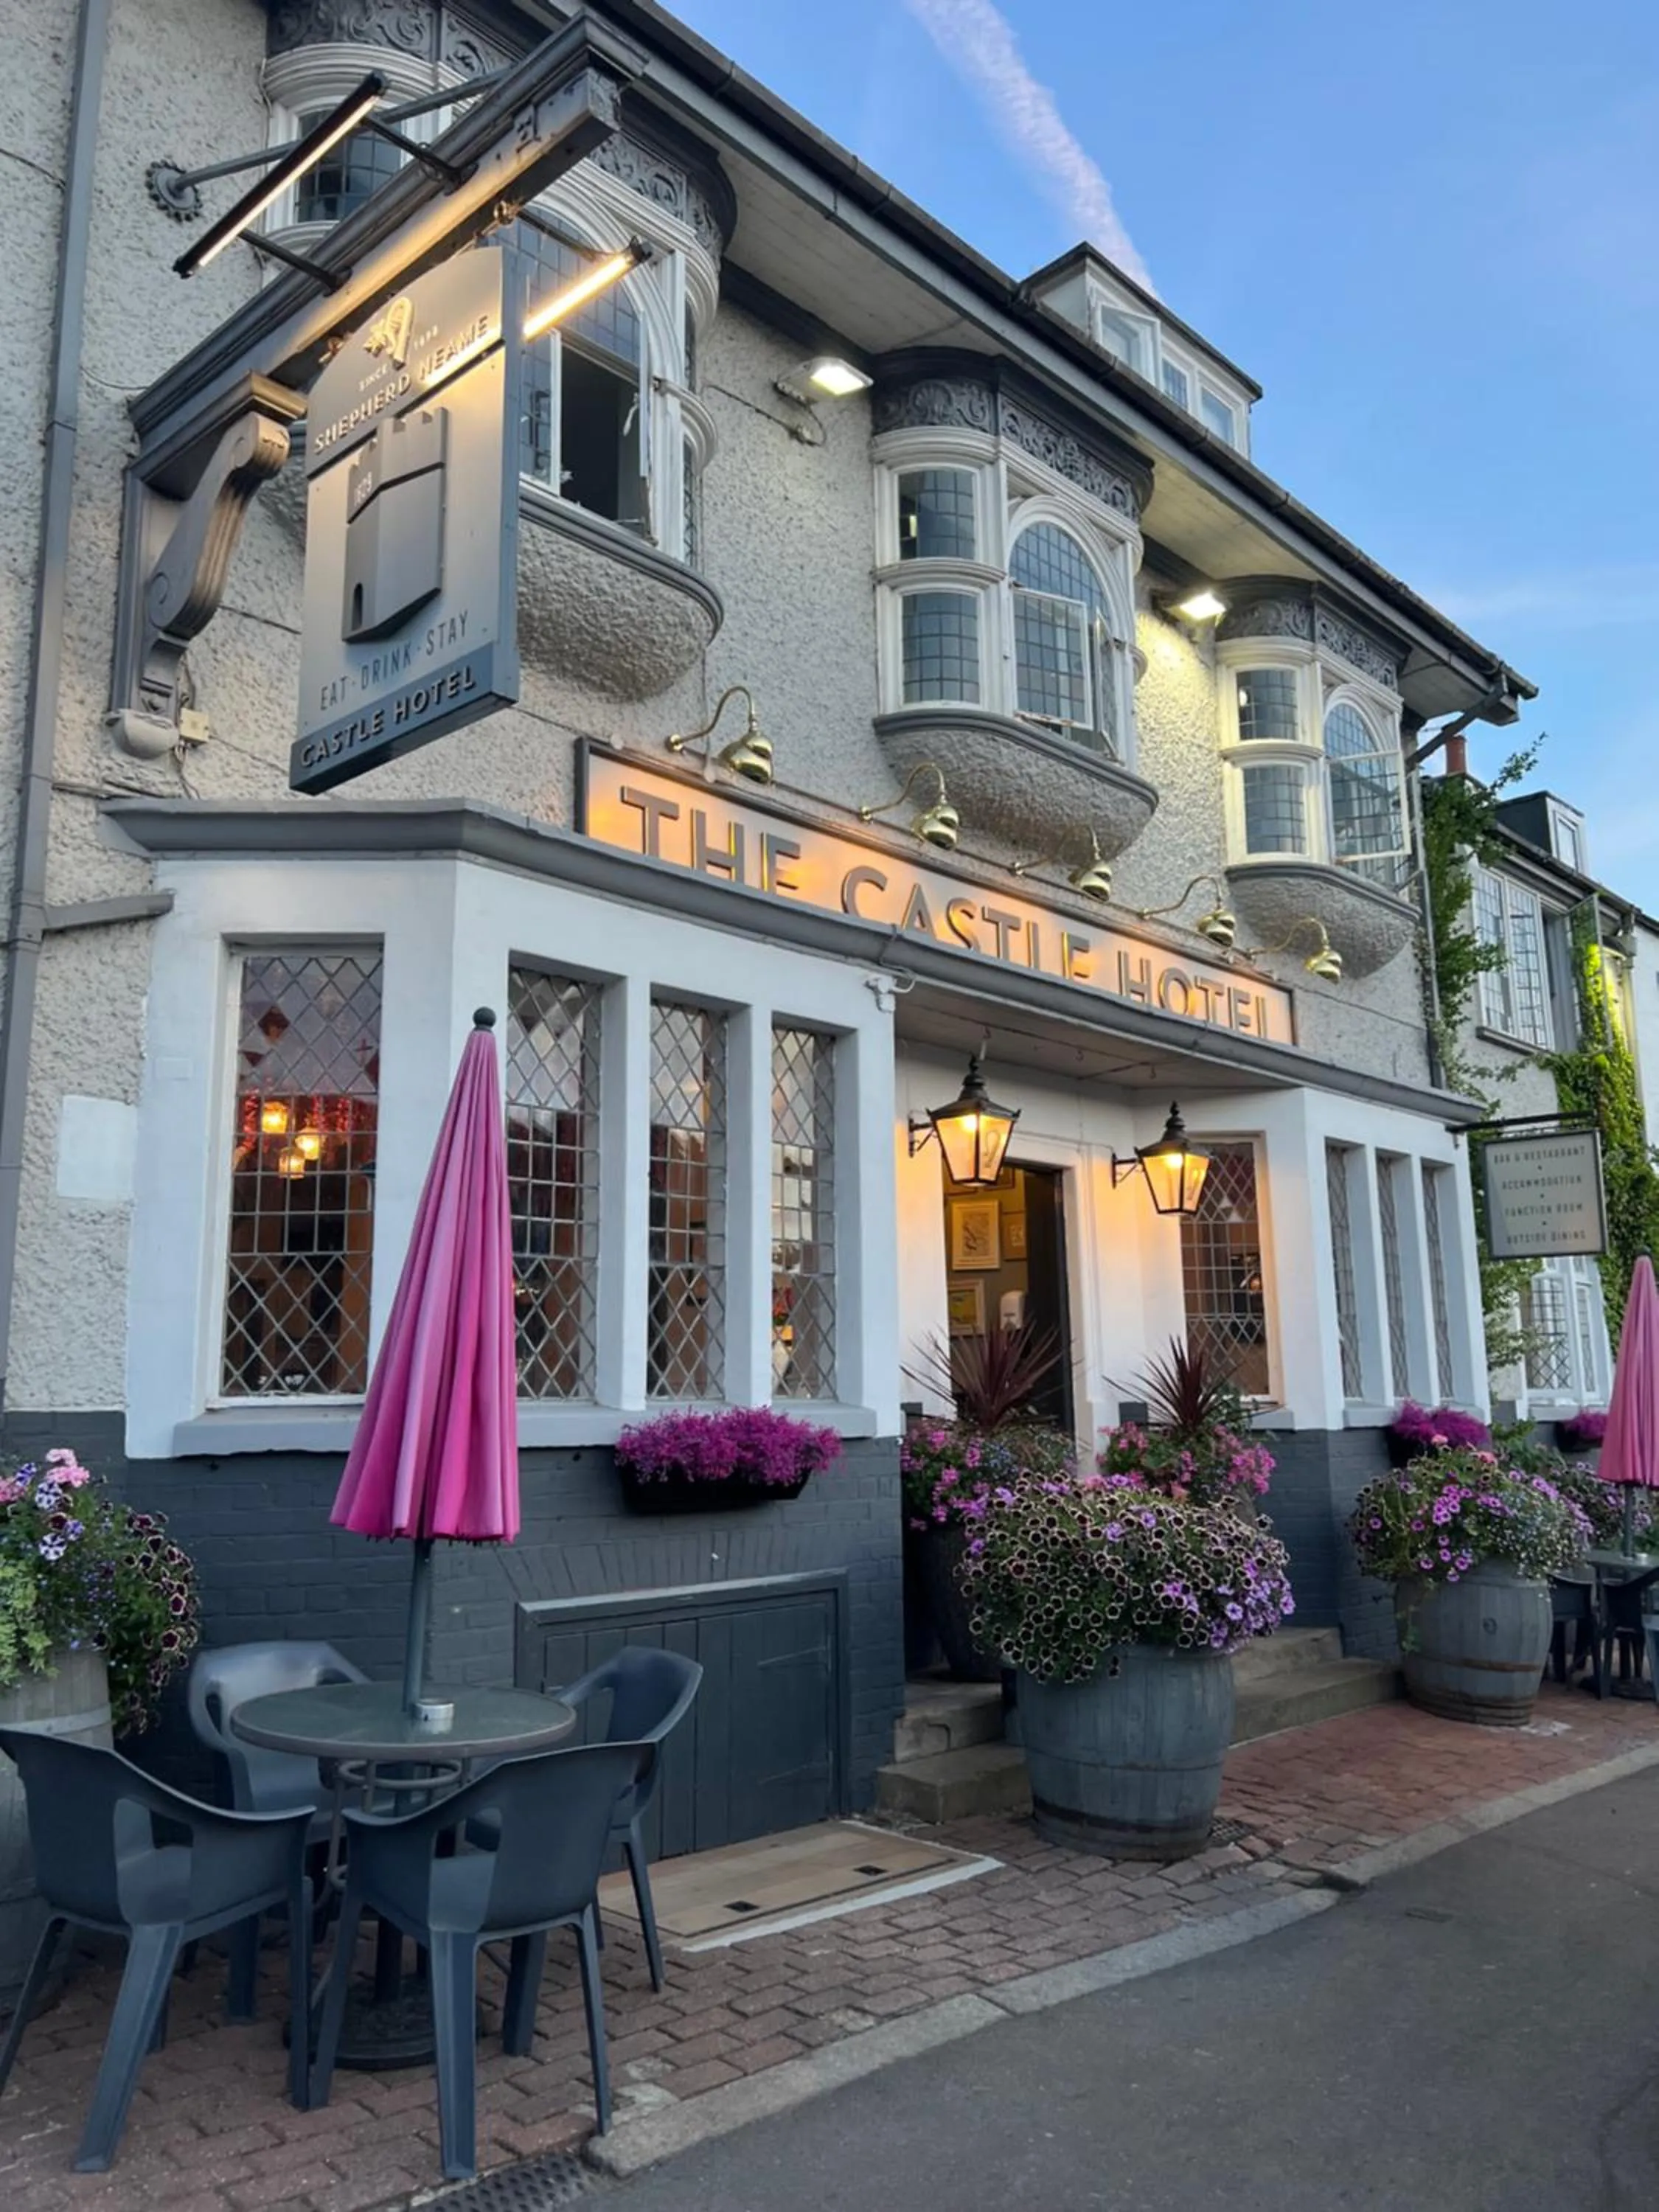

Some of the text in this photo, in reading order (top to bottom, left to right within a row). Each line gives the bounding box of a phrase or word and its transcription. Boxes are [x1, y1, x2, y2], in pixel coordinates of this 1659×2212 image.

[314, 315, 489, 456] SHEPHERD NEAME
[301, 665, 476, 768] CASTLE HOTEL
[320, 609, 468, 710] EAT DRINK STAY
[620, 785, 1267, 1039] THE CASTLE HOTEL
